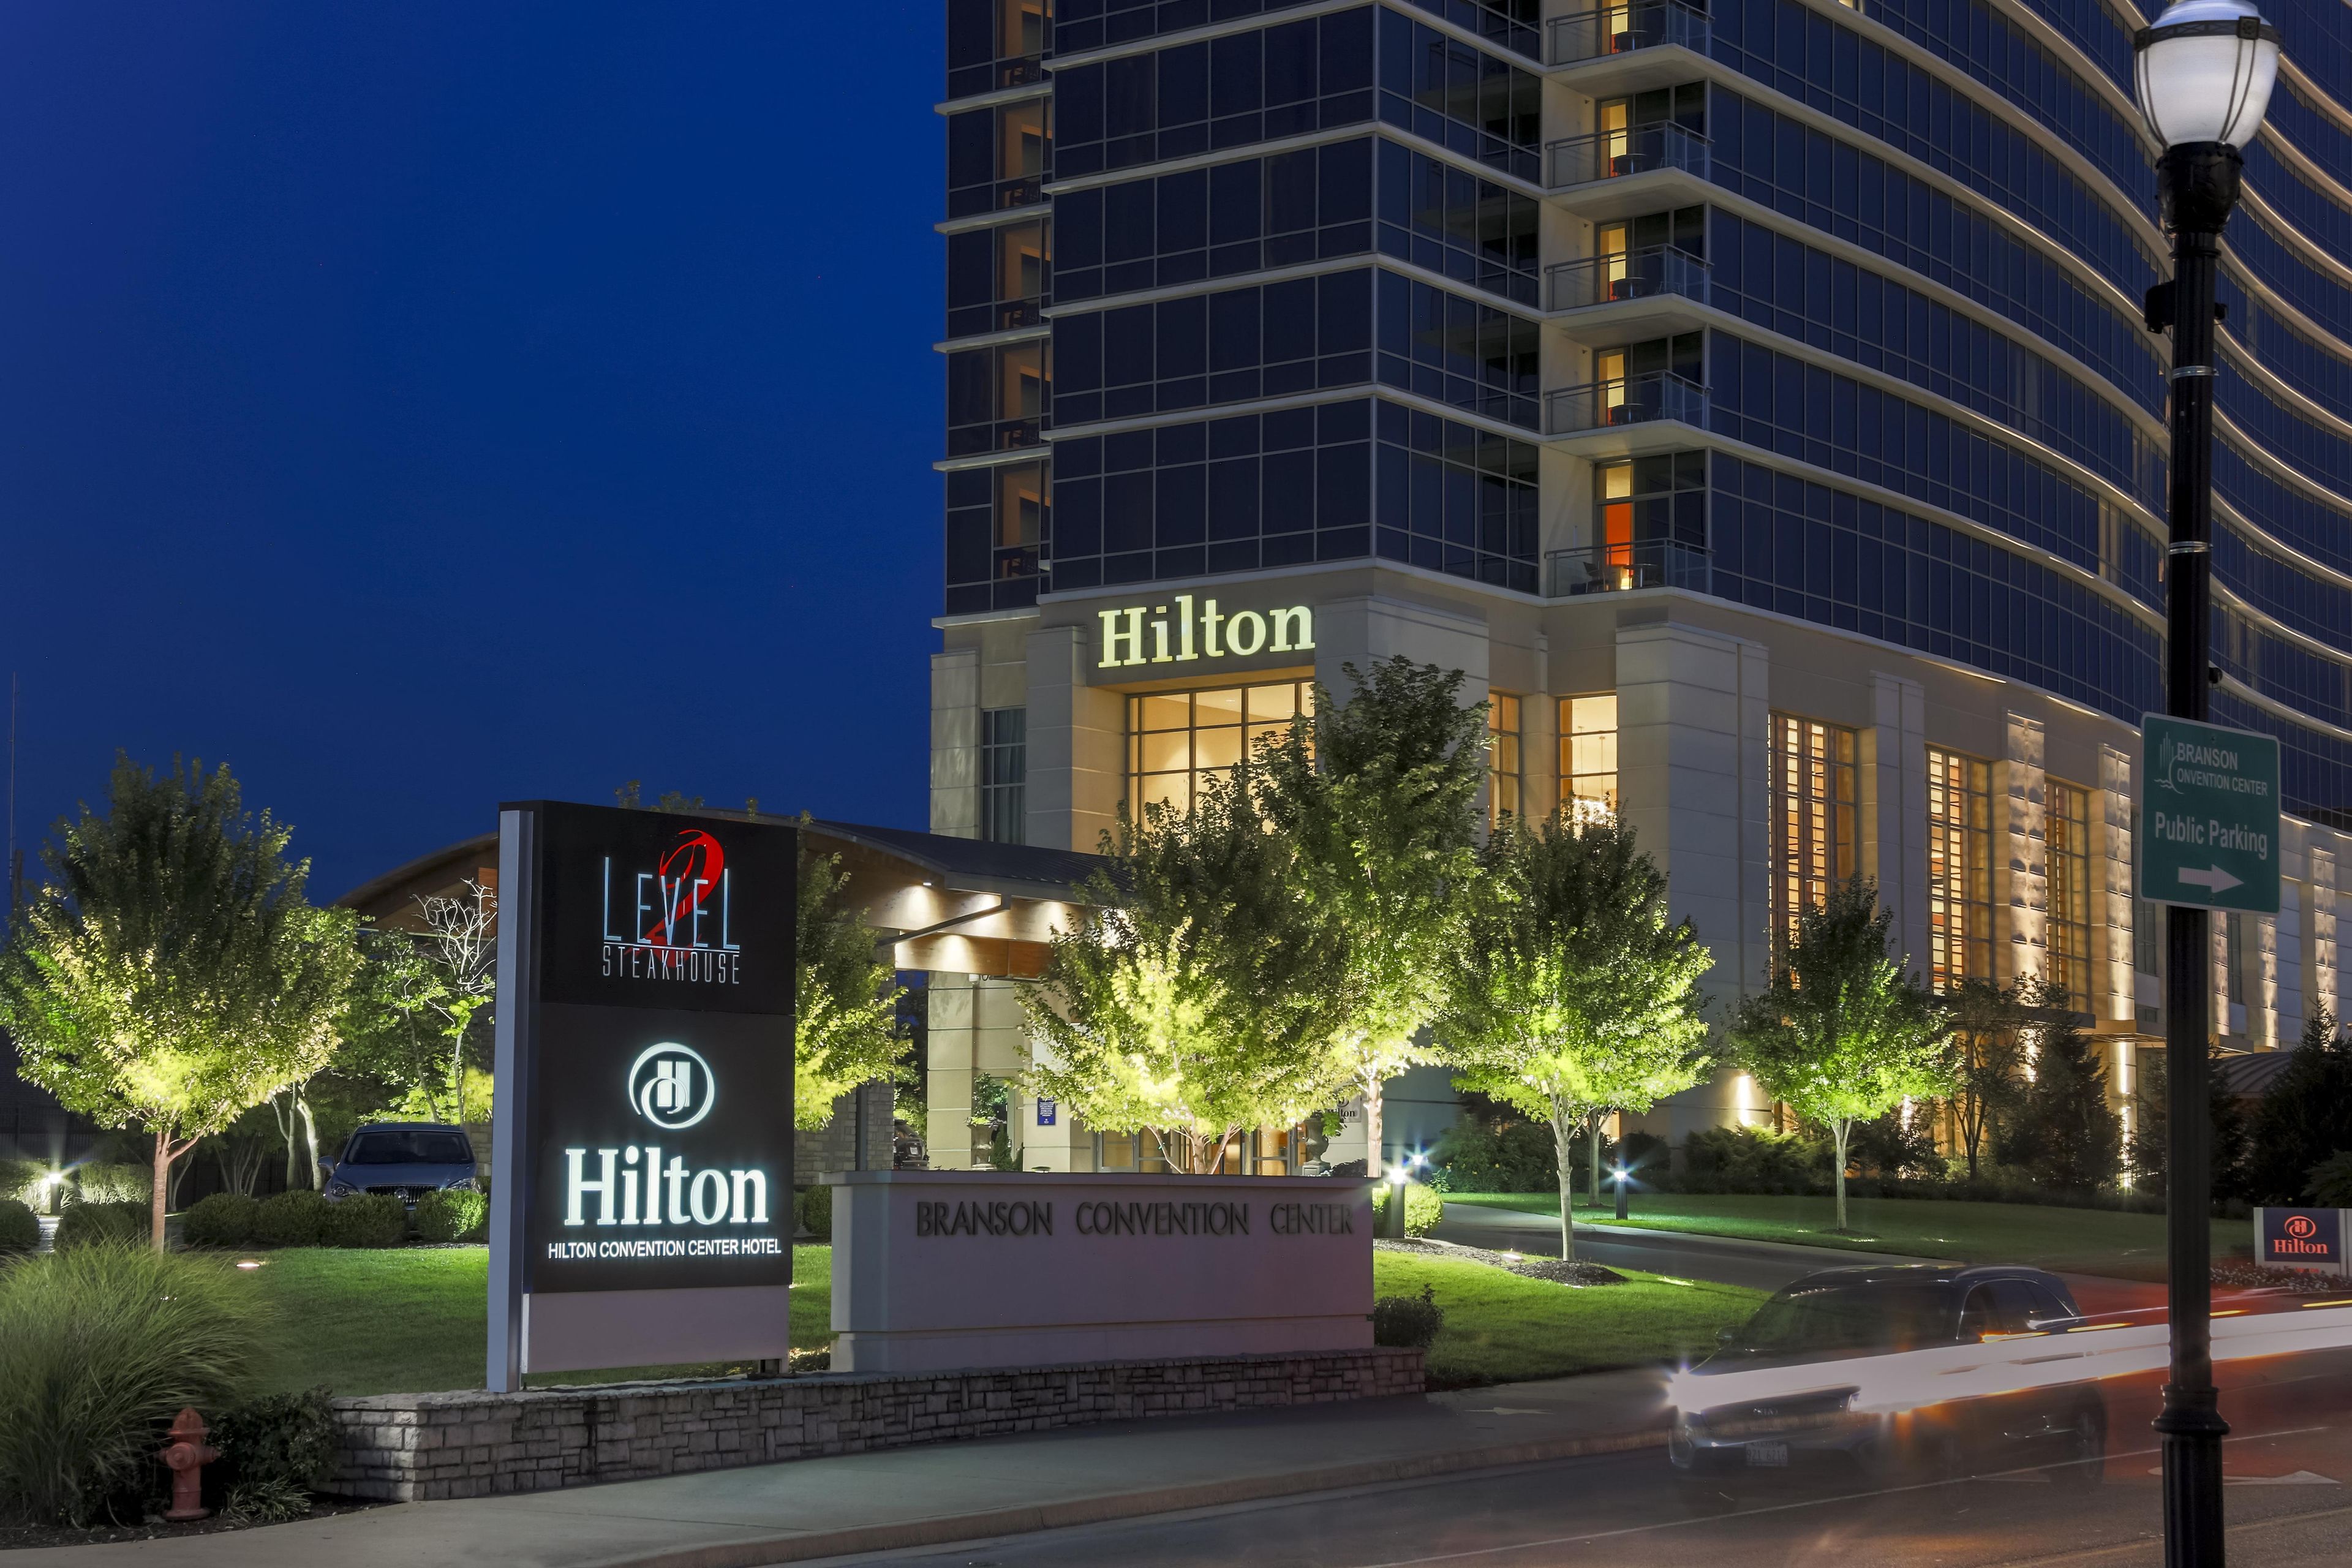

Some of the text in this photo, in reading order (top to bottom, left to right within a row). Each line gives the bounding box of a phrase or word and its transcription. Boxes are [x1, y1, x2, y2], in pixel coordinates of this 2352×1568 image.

[1098, 594, 1316, 668] Hilton
[2177, 742, 2238, 771] BRANSON
[2232, 777, 2268, 796] CENTER
[2155, 812, 2267, 860] Public Parking
[603, 856, 740, 950] LEVEL
[603, 945, 740, 984] STEAKHOUSE
[564, 1145, 769, 1226] Hilton
[916, 1200, 1355, 1236] BRANSON CONVENTION CENTER
[548, 1238, 782, 1259] HILTON CONVENTION CENTER HOTEL
[2273, 1238, 2328, 1254] Hilton
